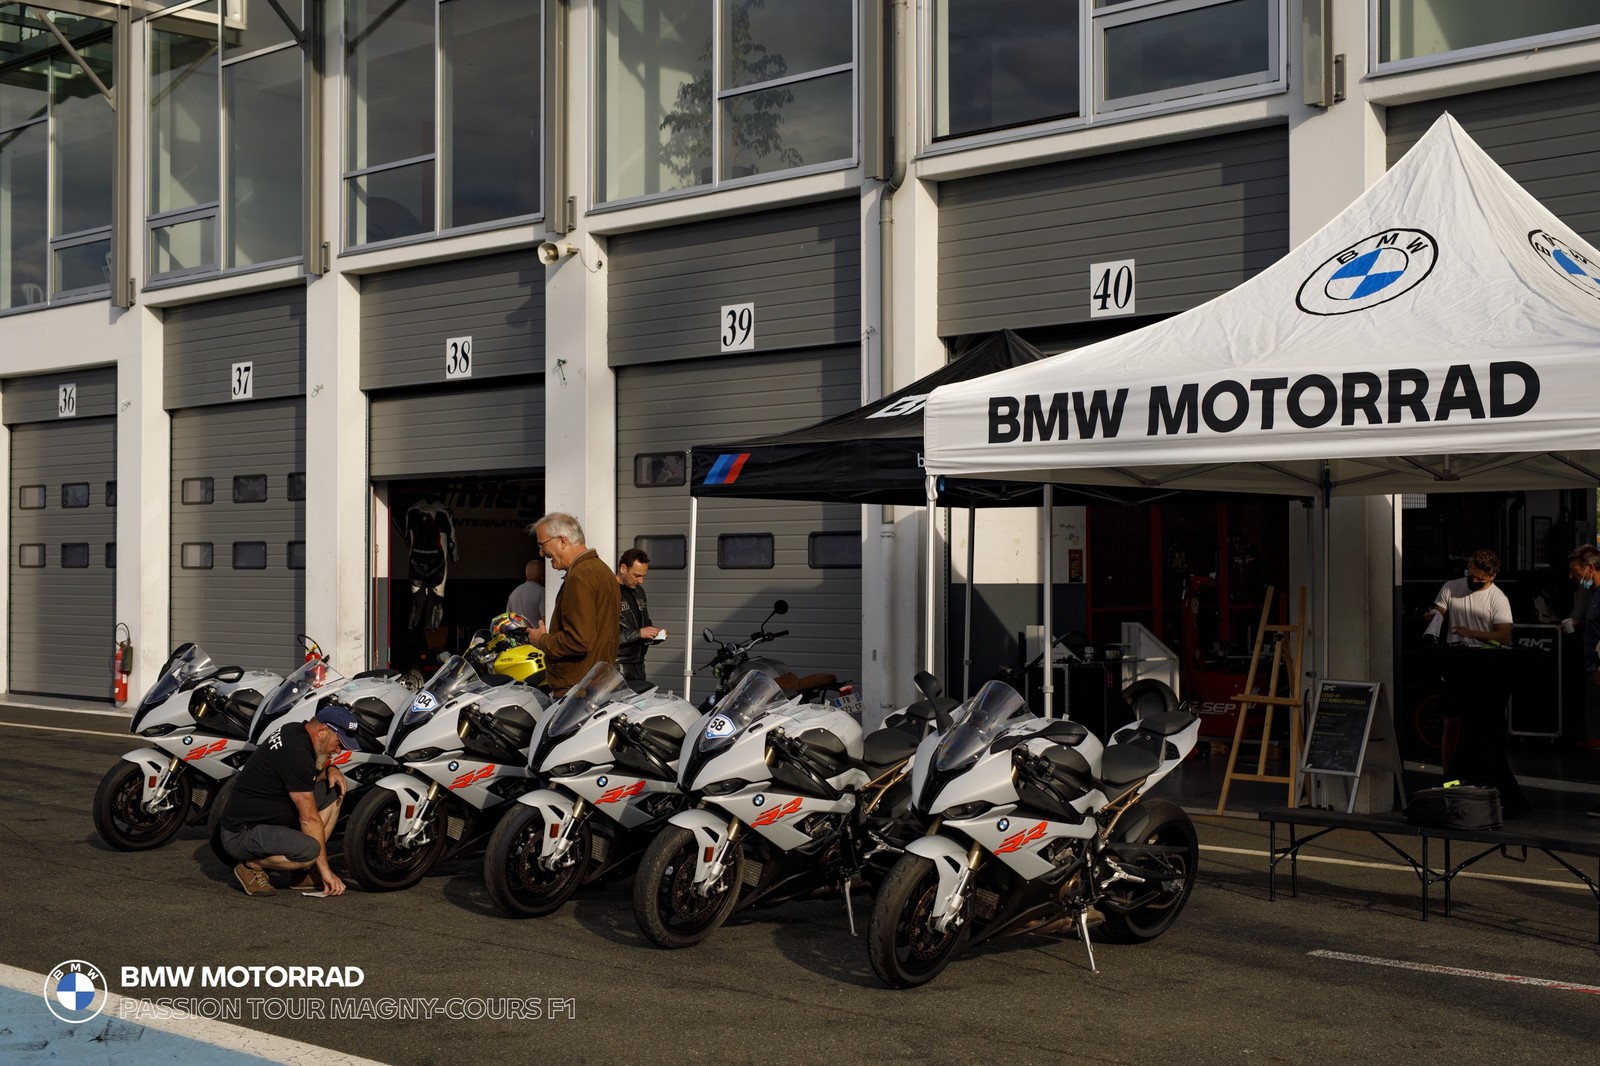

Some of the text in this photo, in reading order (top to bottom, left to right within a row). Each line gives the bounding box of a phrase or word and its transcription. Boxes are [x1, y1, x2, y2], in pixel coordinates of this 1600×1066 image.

[1336, 232, 1428, 265] BMW
[1092, 265, 1134, 311] 40
[722, 308, 753, 347] 39
[447, 341, 470, 375] 38
[233, 367, 252, 395] 37
[60, 388, 75, 414] 36
[988, 361, 1540, 444] BMW MOTORRAD
